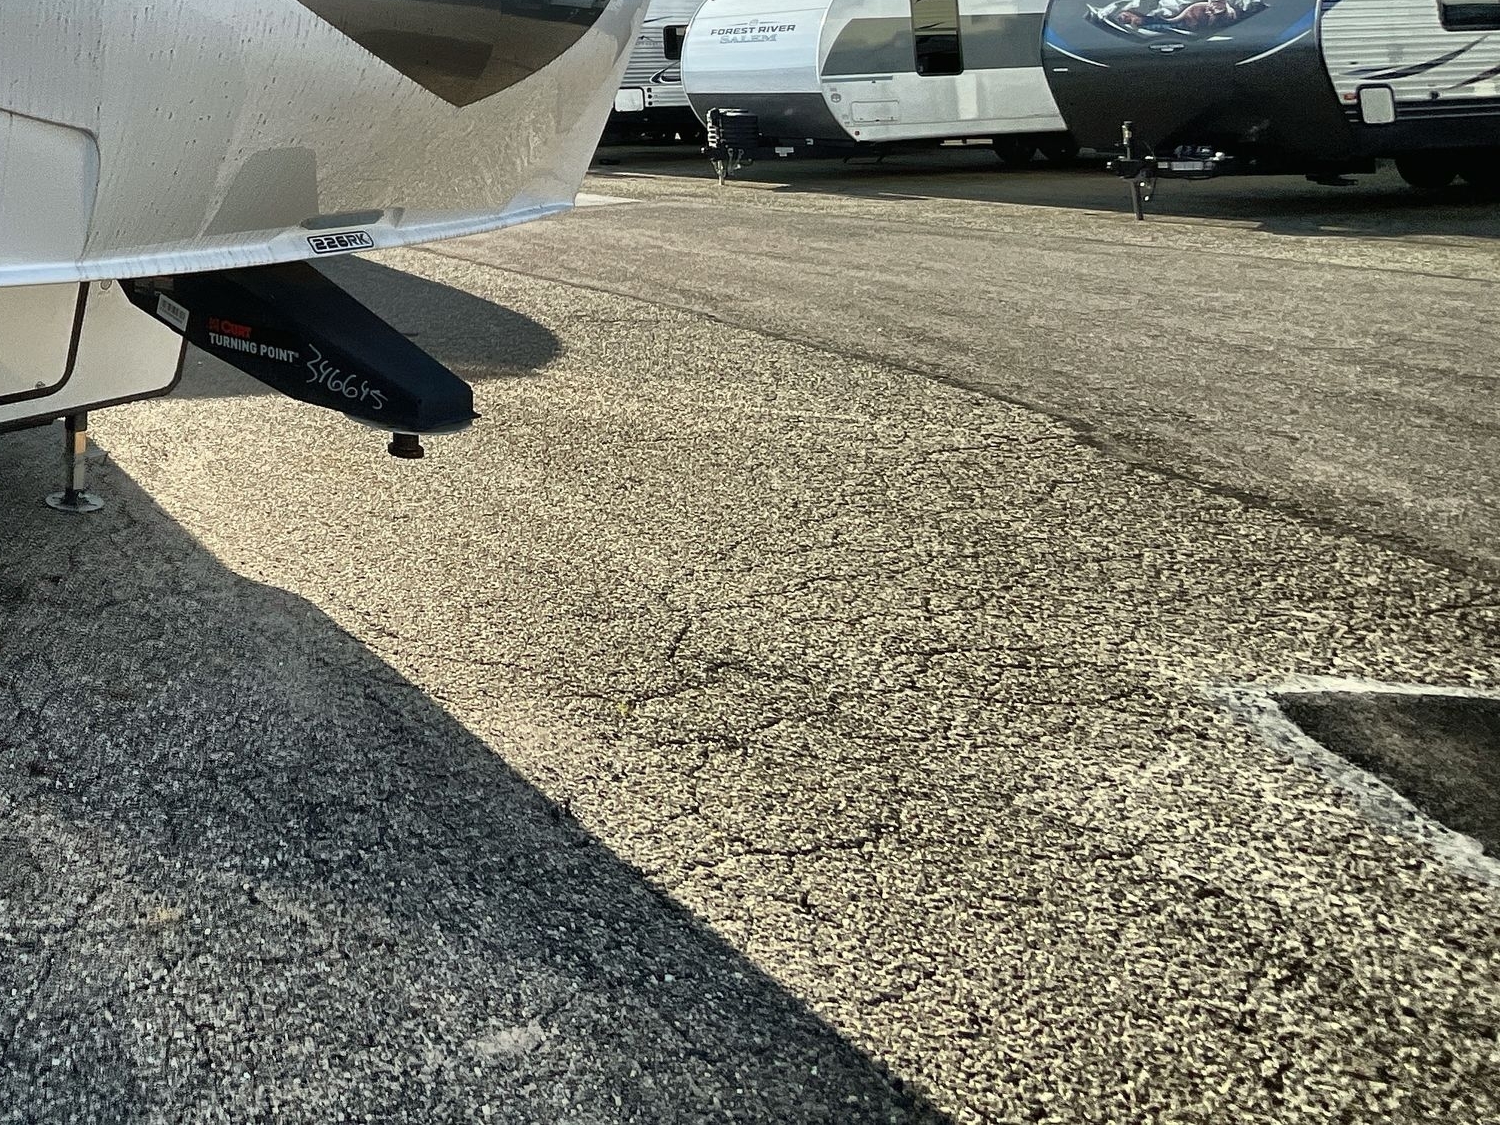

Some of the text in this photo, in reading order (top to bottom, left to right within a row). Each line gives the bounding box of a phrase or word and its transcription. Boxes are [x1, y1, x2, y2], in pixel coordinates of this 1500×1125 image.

[710, 24, 796, 35] FOREST RIVER
[720, 34, 777, 43] SALEM
[312, 234, 370, 250] 226RK
[208, 332, 258, 355] TURNING
